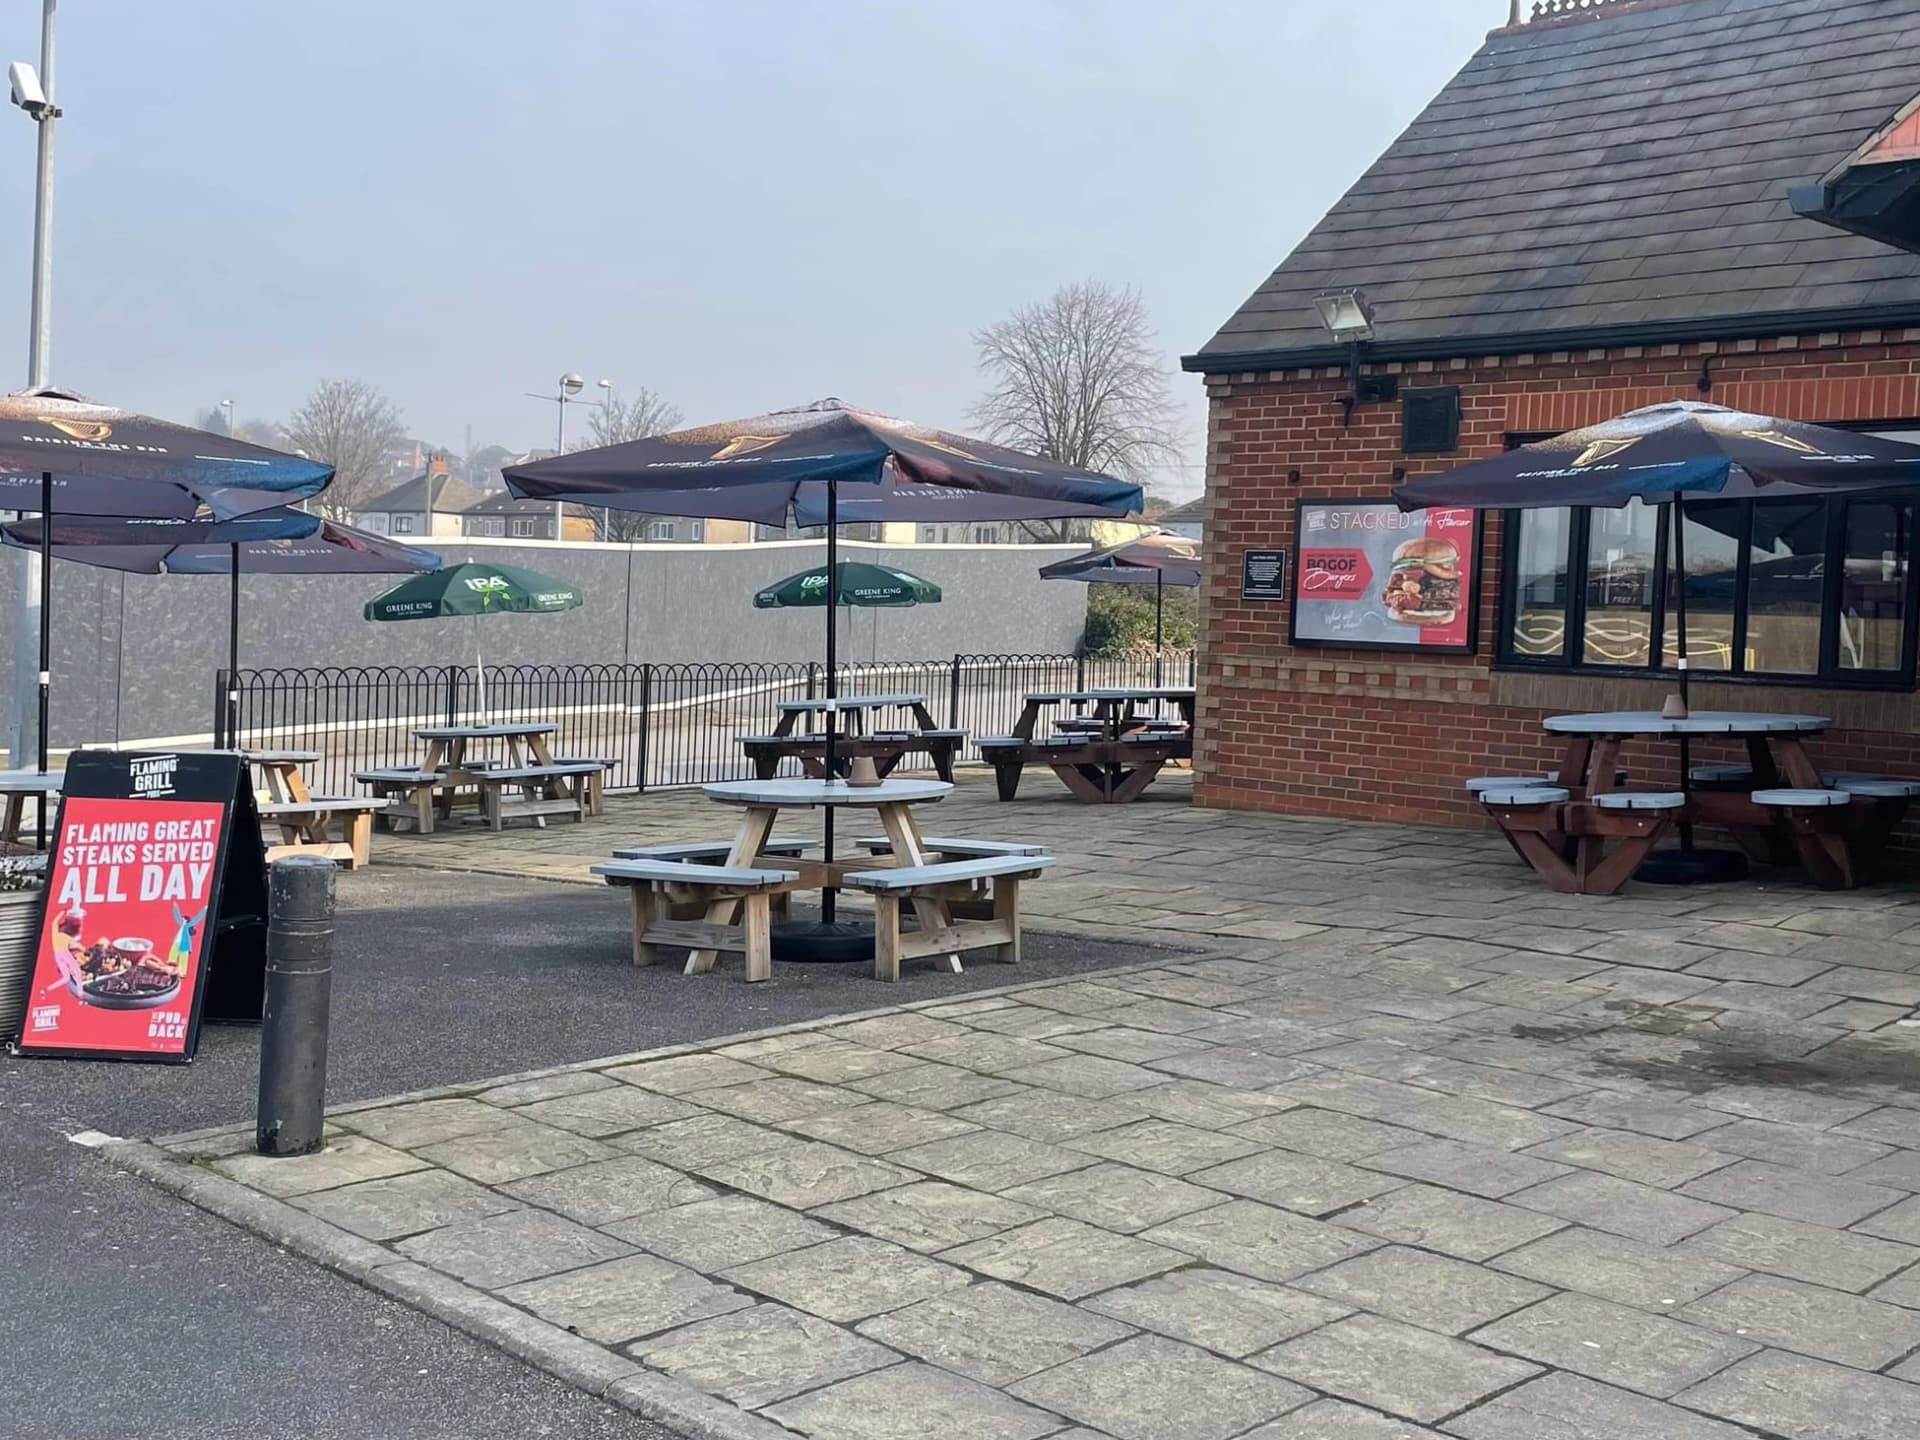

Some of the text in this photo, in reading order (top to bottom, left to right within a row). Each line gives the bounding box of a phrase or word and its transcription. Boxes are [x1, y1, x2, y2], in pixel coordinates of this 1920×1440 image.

[1330, 512, 1410, 530] STACKED
[1307, 559, 1357, 571] BOGOF
[464, 576, 510, 590] IPA
[385, 603, 414, 613] GREENE
[415, 601, 433, 610] KING
[130, 759, 177, 777] FLAMING
[135, 772, 173, 791] GRILL
[66, 819, 215, 844] FLAMING GREAT
[62, 841, 215, 865] STEAKS SERVED
[58, 862, 212, 904] ALL DAY
[148, 1023, 185, 1039] BACK
